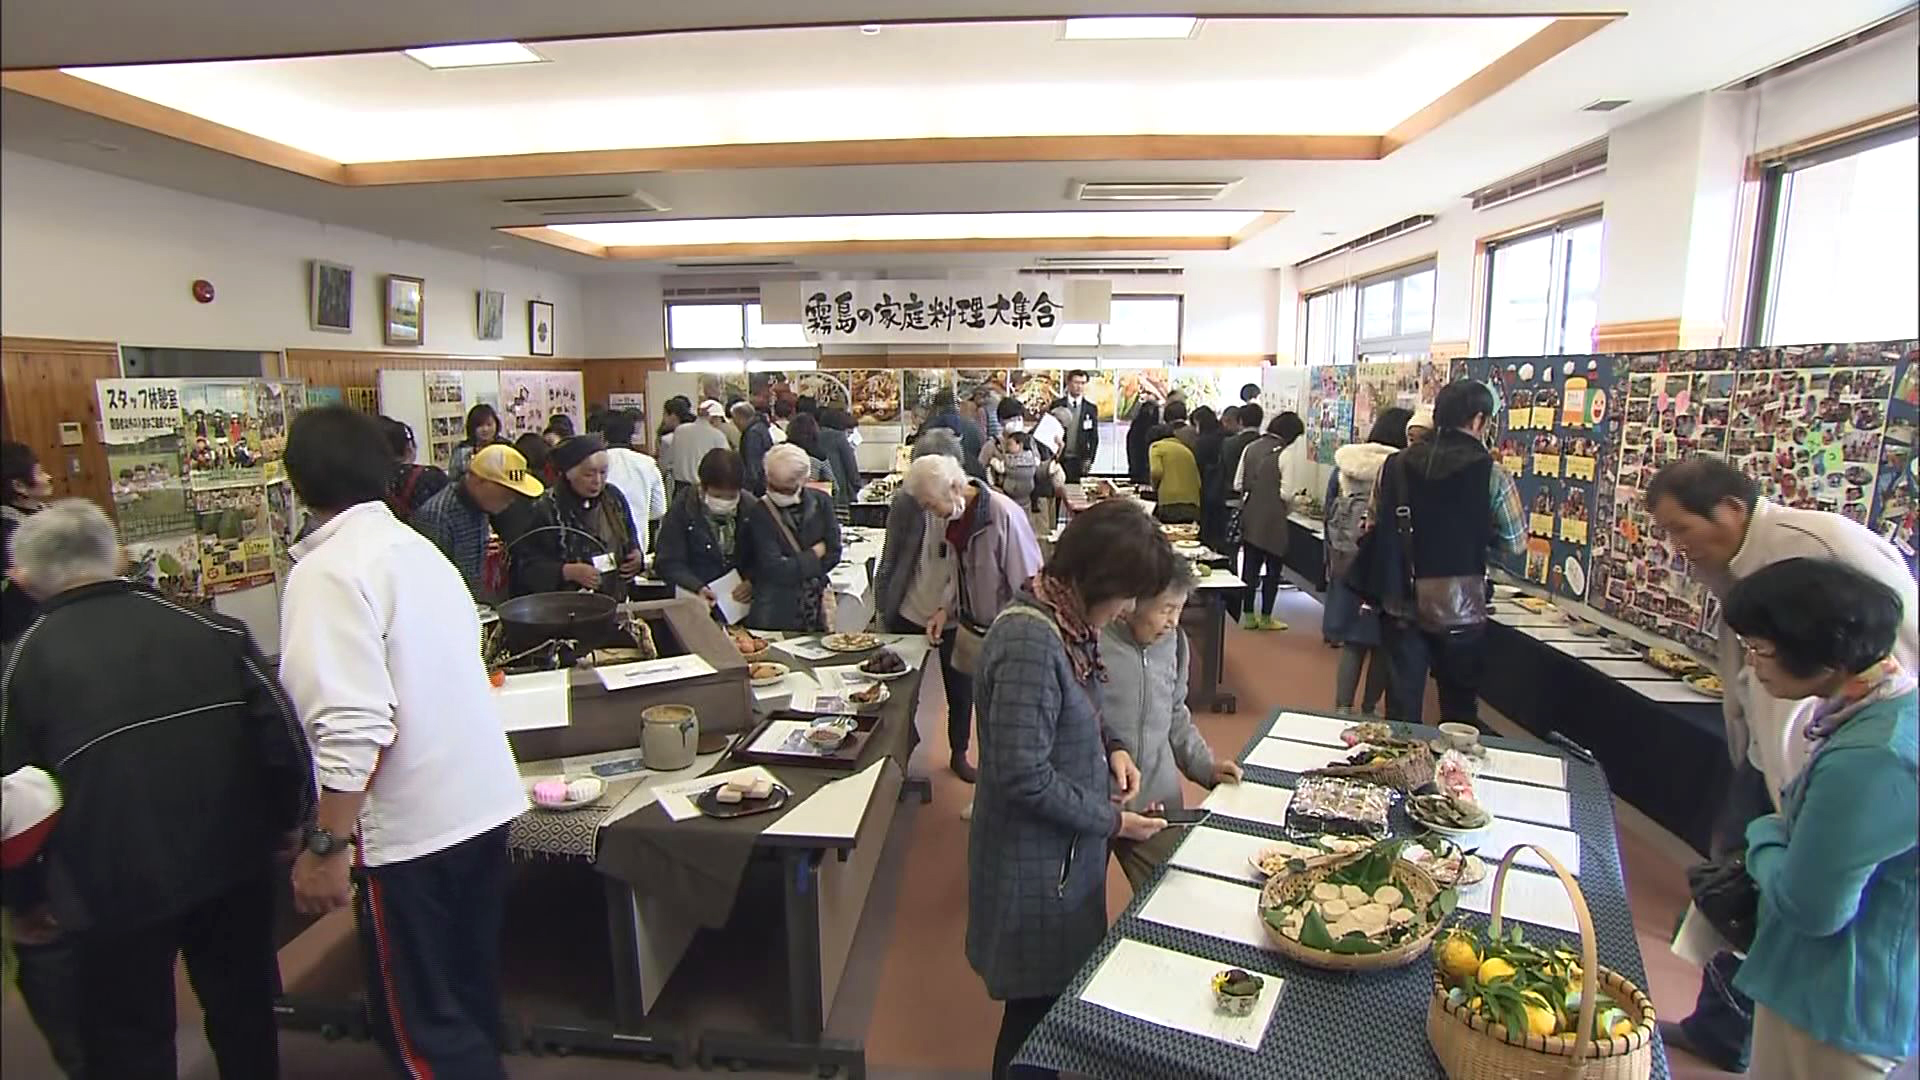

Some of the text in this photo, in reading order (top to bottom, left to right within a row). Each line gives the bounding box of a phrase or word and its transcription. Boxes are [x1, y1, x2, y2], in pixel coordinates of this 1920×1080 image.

[805, 291, 1063, 334] 霧島の家庭料理大集合
